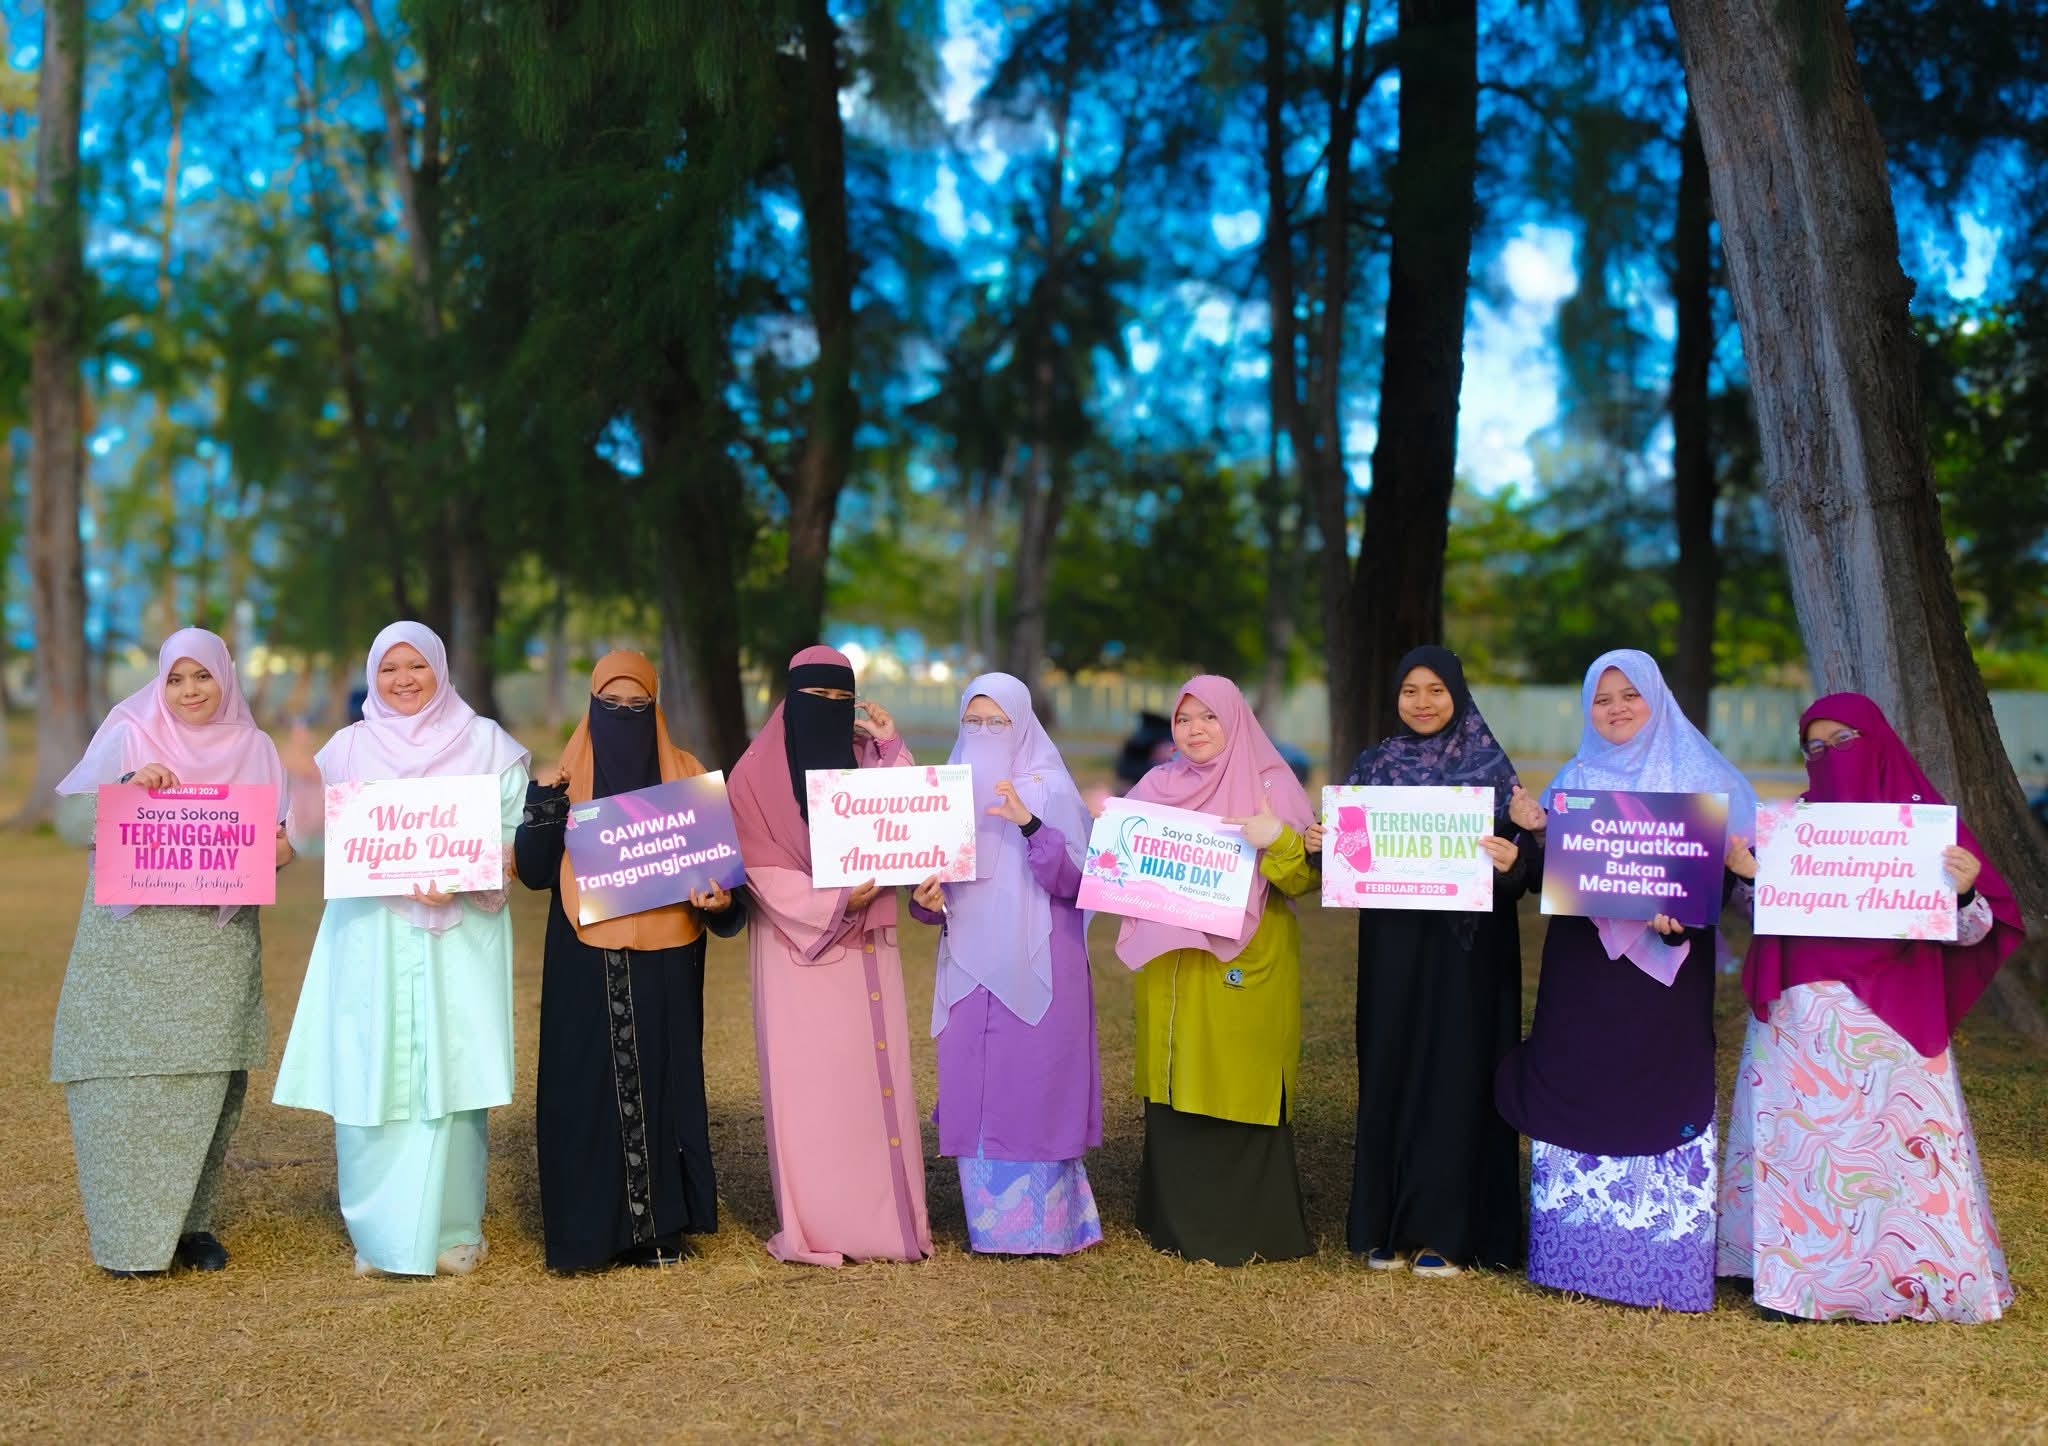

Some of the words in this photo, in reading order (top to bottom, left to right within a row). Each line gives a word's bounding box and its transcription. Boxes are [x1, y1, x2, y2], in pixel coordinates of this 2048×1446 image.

[199, 787, 218, 795] 2026
[137, 807, 176, 822] Saya
[181, 808, 239, 823] Sokong
[831, 791, 951, 818] Qawwam
[368, 804, 458, 832] World
[600, 809, 696, 846] QAWWAM
[873, 818, 912, 842] Itu
[1370, 812, 1484, 833] TERENGGANU
[1591, 819, 1685, 837] QAWWAM
[119, 823, 256, 846] TERENGGANU
[619, 834, 687, 861] Adalah
[1162, 826, 1193, 842] Saya
[1196, 832, 1242, 854] Sokong
[1375, 834, 1433, 859] HIJAB
[1440, 836, 1480, 859] DAY
[1562, 833, 1710, 859] Menguatkan.
[1795, 822, 1909, 848] Qawwam
[135, 847, 192, 870] HIJAB
[200, 848, 239, 870] DAY
[344, 836, 417, 869] Hijab
[426, 833, 485, 863] Day
[840, 845, 949, 874] Amanah
[1132, 834, 1239, 873] TERENGGANU
[576, 843, 736, 892] Tanggungjawab.
[1139, 856, 1186, 881] HIJAB
[1190, 866, 1223, 889] DAY
[1606, 861, 1666, 878] Bukan
[1791, 854, 1916, 884] Memimpin
[1179, 885, 1211, 898] Februari
[1212, 891, 1231, 902] 2026
[1365, 884, 1418, 894] FEBRUARI
[1420, 884, 1447, 895] 2026
[1579, 874, 1688, 898] Menekan.
[1758, 884, 1848, 914] Dengan
[1856, 887, 1948, 912] Akhlak
